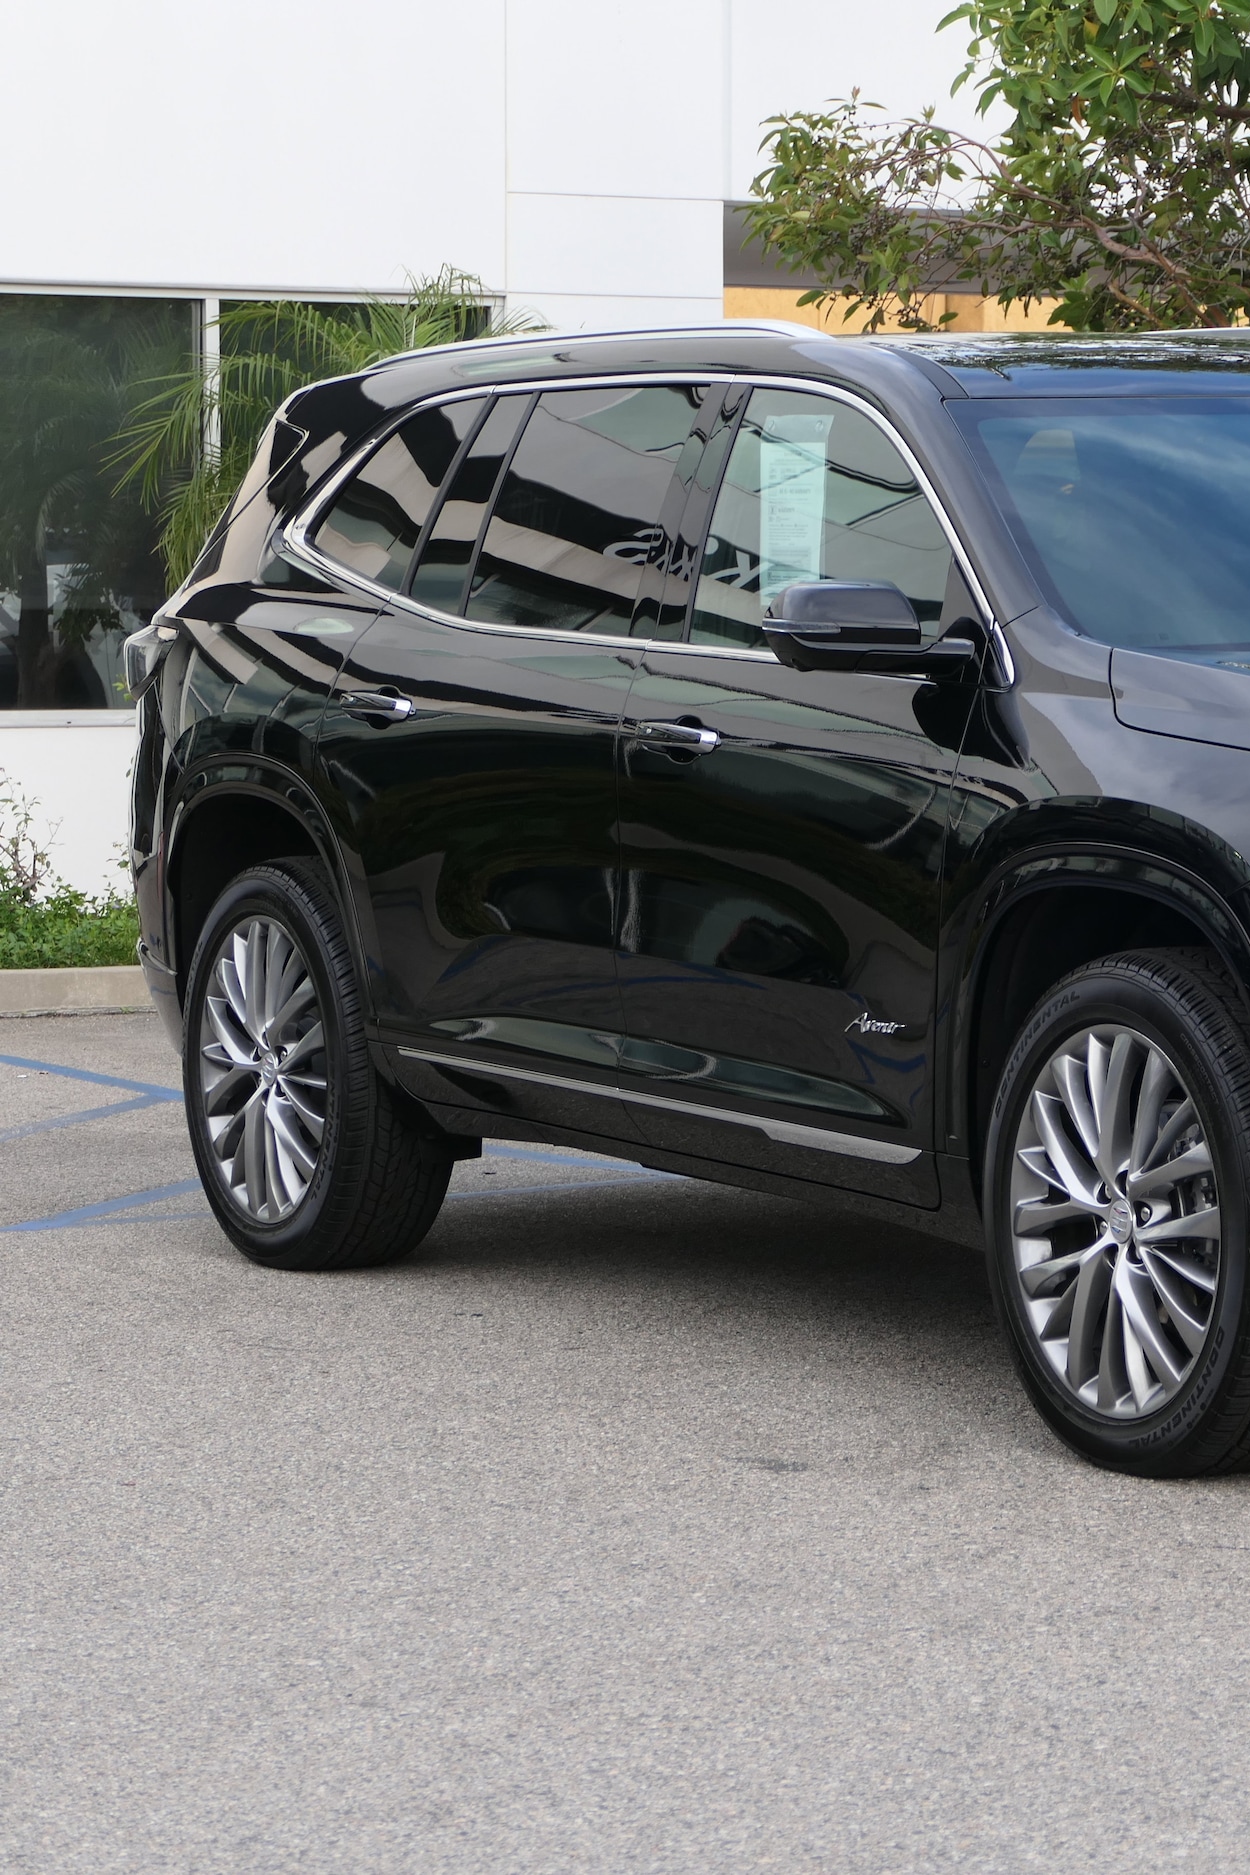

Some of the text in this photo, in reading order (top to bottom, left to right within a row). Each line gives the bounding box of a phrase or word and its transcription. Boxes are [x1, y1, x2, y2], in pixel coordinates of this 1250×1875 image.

[844, 1012, 906, 1034] Avenir
[995, 991, 1080, 1118] CONTINENTAL
[1129, 1326, 1225, 1448] CONTINENTAL
